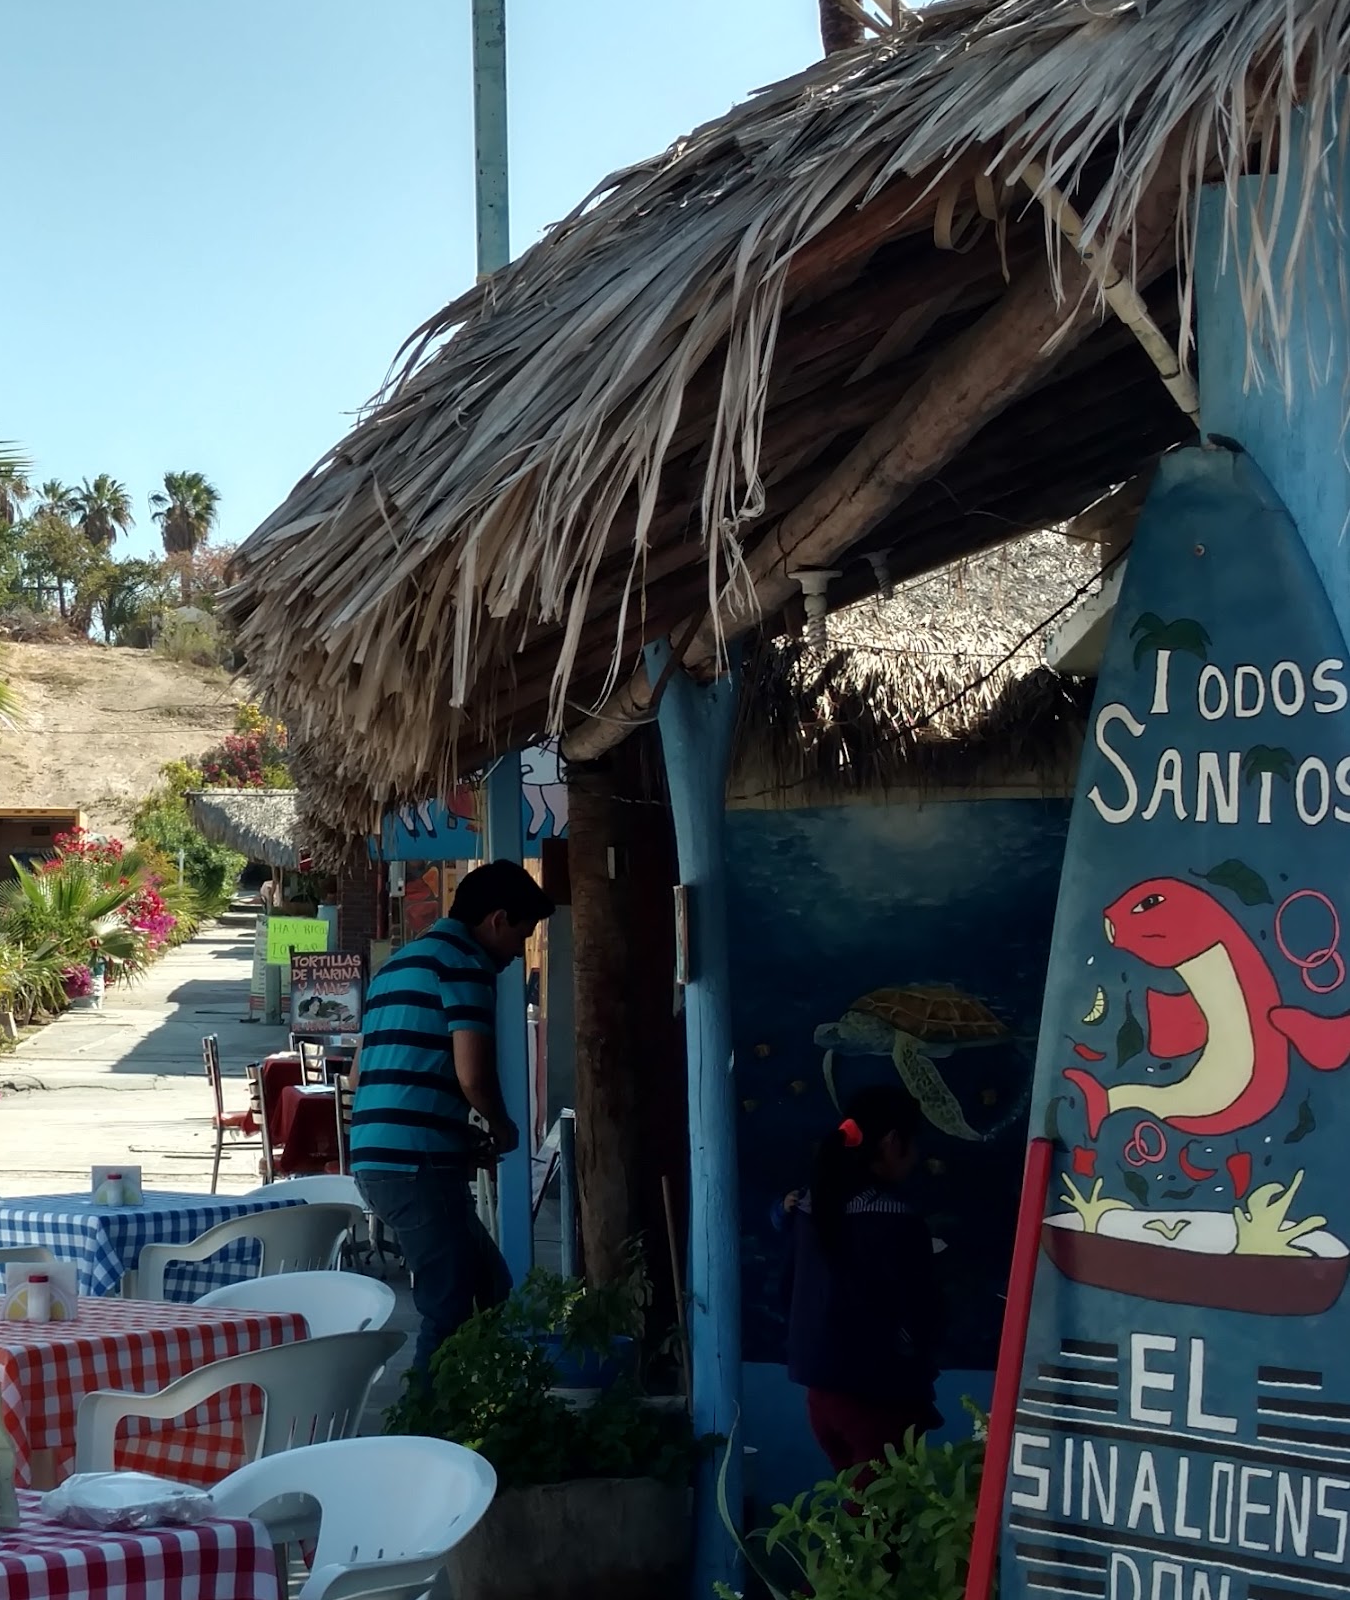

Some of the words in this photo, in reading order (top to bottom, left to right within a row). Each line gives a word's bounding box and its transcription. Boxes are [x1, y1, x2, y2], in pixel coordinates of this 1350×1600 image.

[273, 923, 298, 934] HAY
[292, 954, 361, 968] TORTILLAS
[292, 968, 307, 980] DE
[313, 967, 361, 980] HARINA
[298, 981, 308, 996] Y
[313, 981, 350, 996] MAIZ
[1129, 1331, 1238, 1434] EL
[1011, 1432, 1350, 1565] SINALOENS
